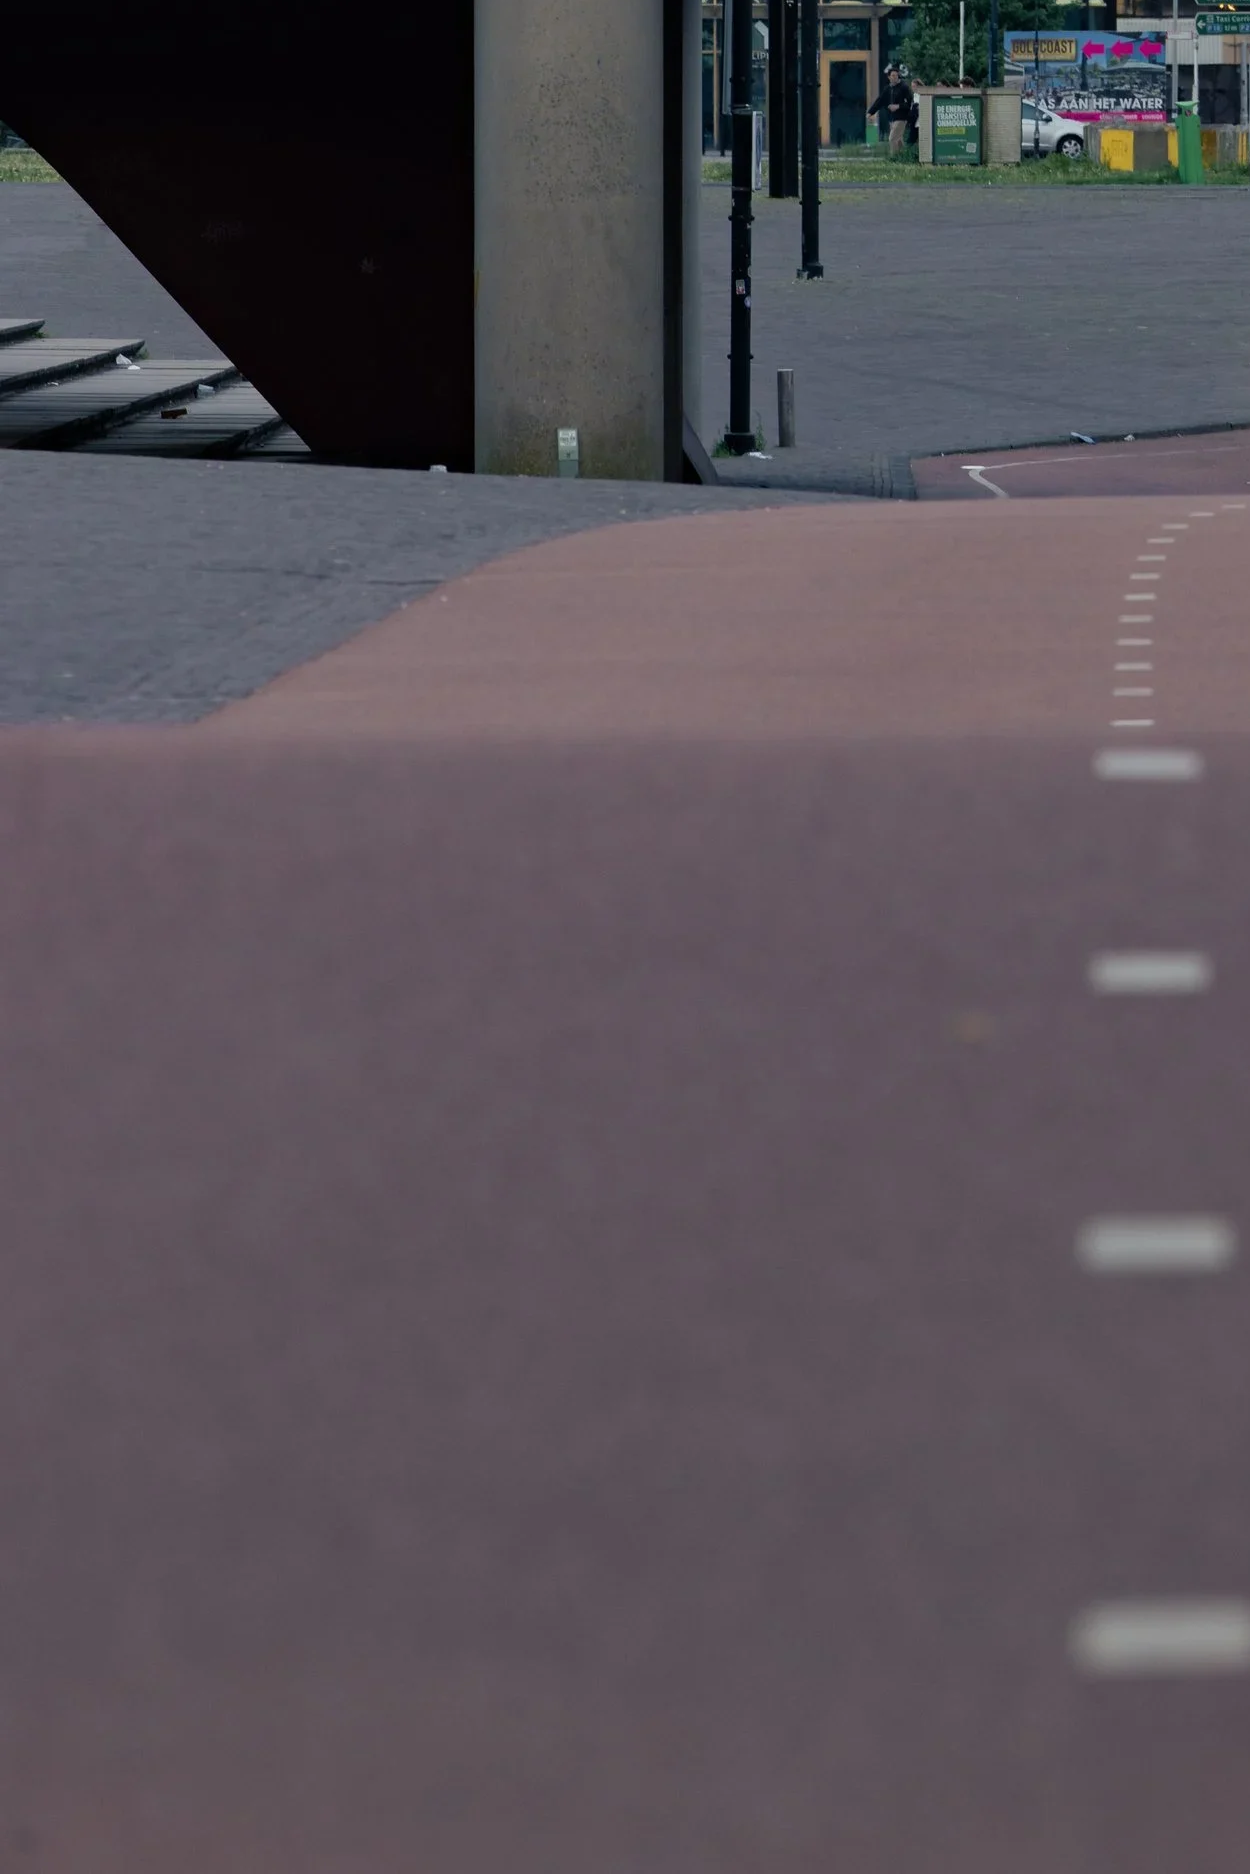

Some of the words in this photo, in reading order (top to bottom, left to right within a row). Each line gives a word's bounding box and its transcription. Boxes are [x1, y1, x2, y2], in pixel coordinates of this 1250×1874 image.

[1012, 40, 1038, 54] GOL
[1040, 40, 1073, 54] COAST
[936, 105, 945, 113] DE
[1060, 98, 1089, 110] AAN
[1093, 98, 1117, 110] HET
[1119, 97, 1163, 110] WATER
